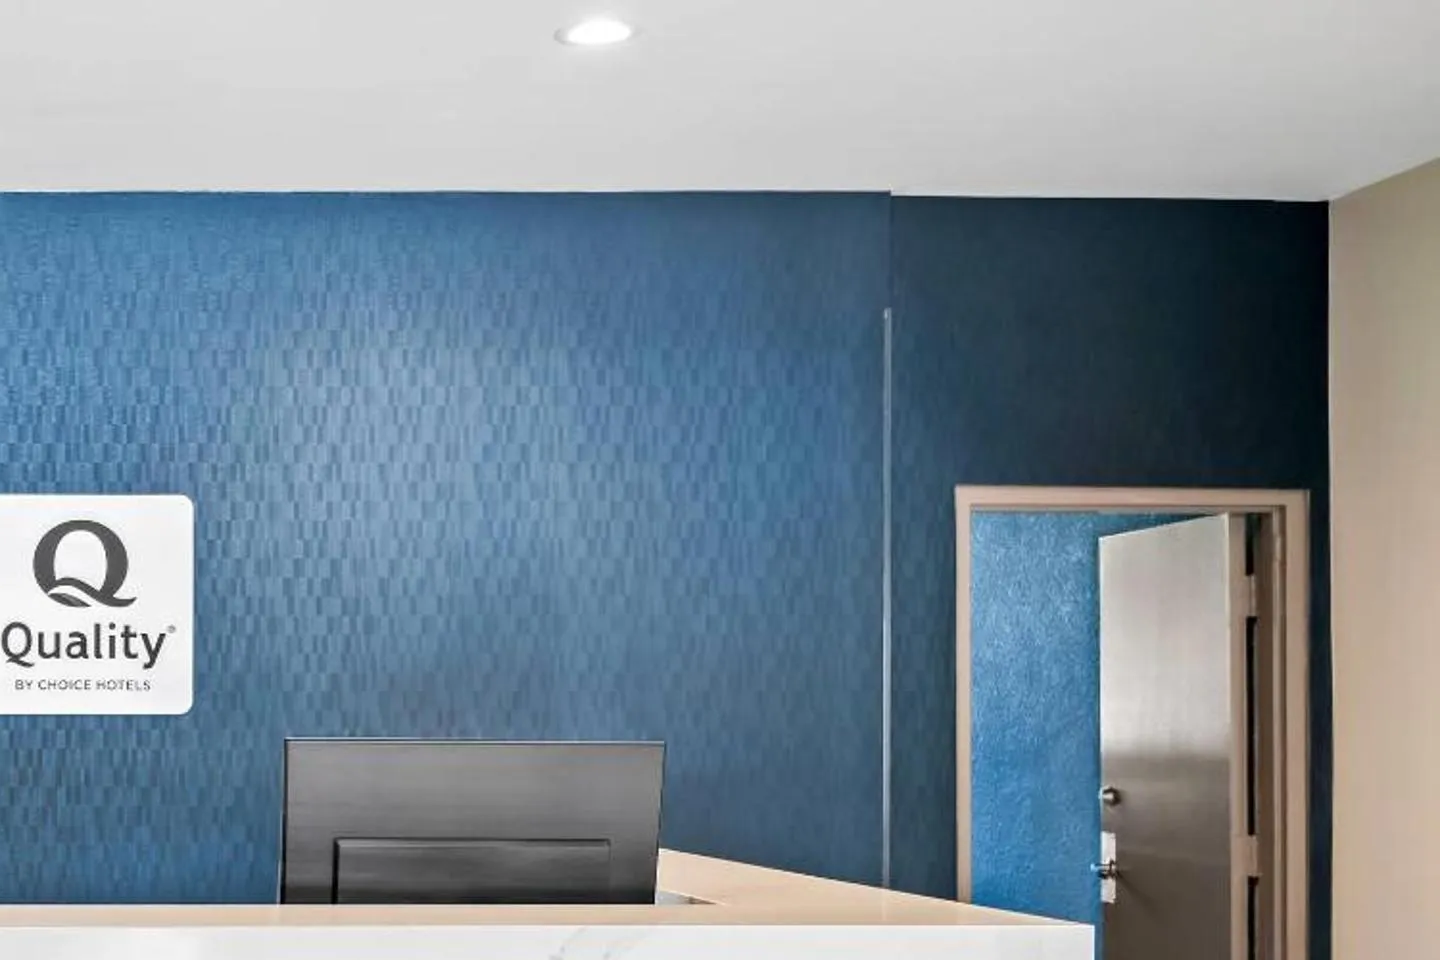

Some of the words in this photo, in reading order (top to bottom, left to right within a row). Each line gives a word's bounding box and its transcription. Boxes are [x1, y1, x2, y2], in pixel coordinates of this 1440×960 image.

[32, 519, 137, 608] Q
[1, 621, 167, 670] Quality
[14, 679, 33, 691] BY
[37, 679, 92, 691] CHOICE
[95, 679, 151, 691] HOTELS
